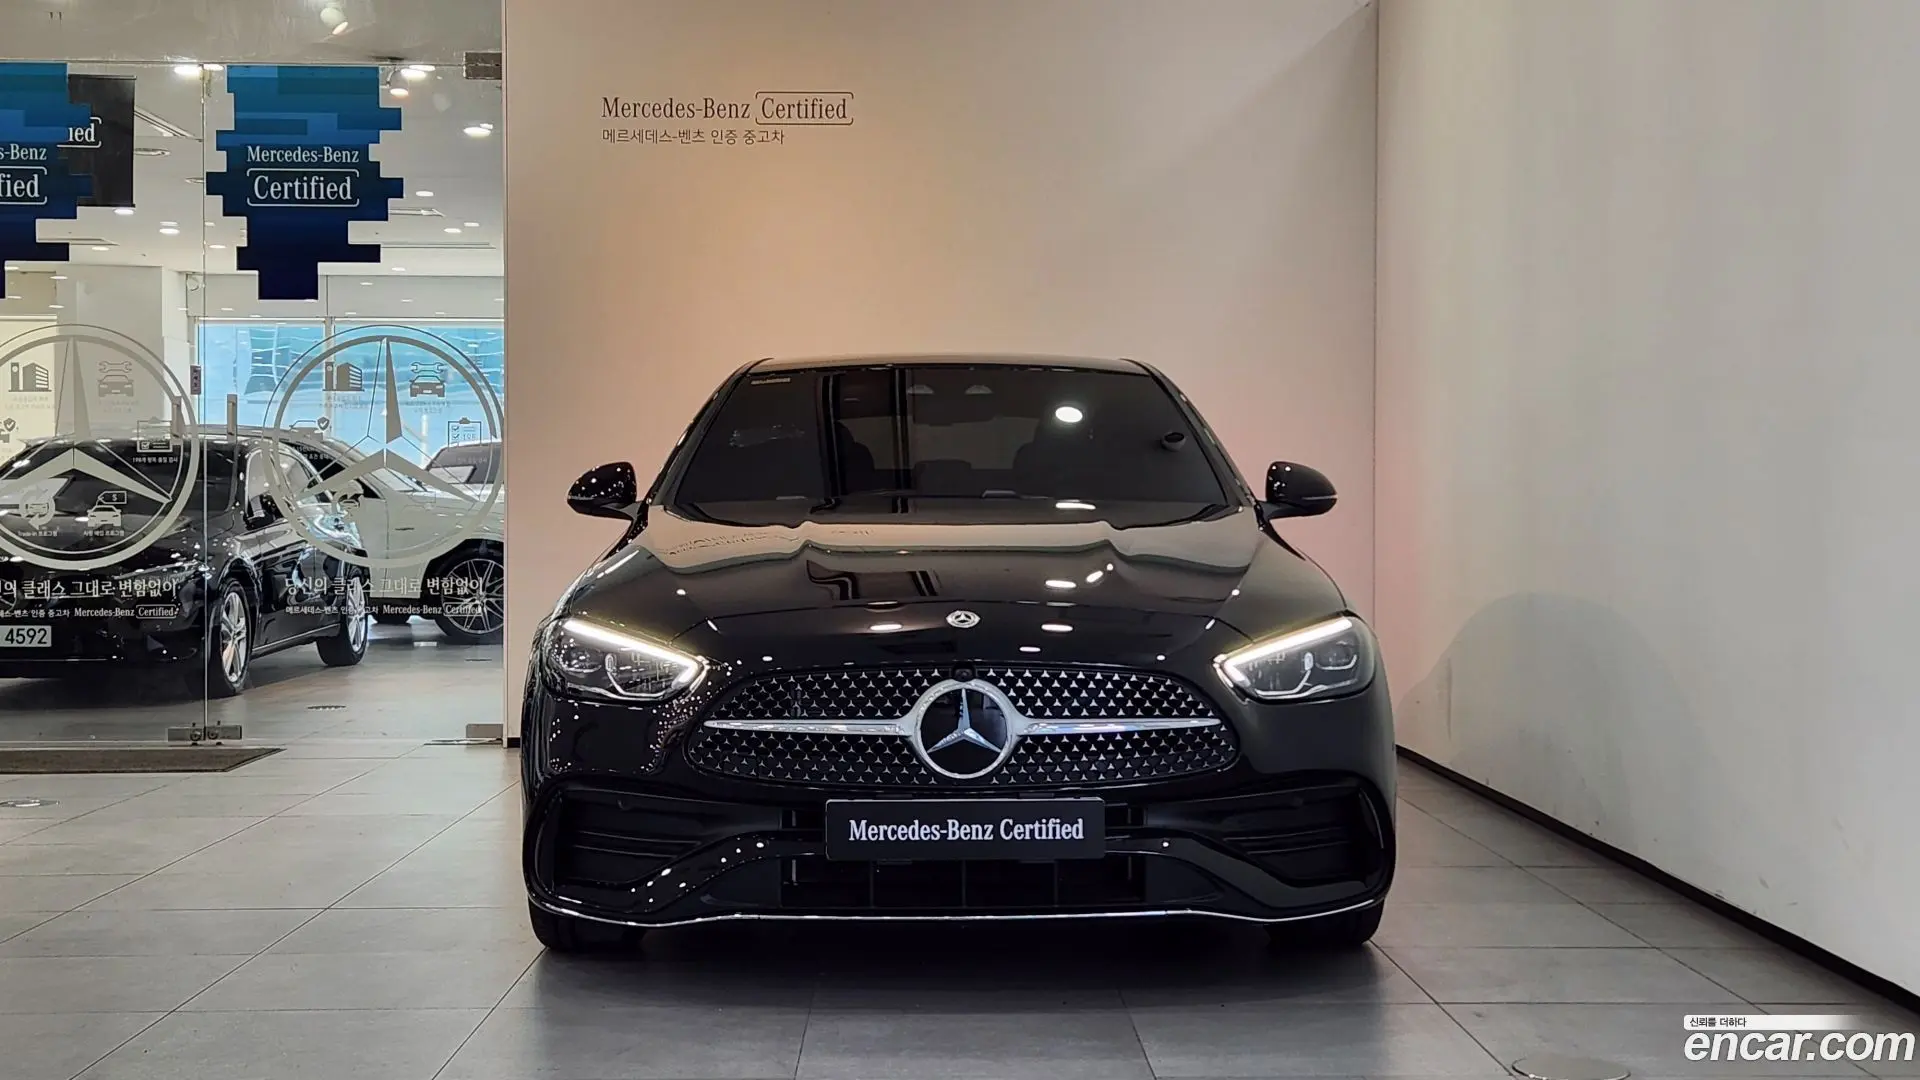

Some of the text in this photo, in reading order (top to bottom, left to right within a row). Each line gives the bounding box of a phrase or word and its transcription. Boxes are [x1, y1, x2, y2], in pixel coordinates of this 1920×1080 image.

[601, 97, 847, 120] Mercedes-Benz Certified
[602, 129, 785, 145] 메르세데스-벤츠 인증 중고차
[246, 145, 360, 163] Mercedes-Benz
[253, 175, 352, 201] Certified
[22, 579, 66, 600] 클래스
[70, 579, 115, 598] 그대로
[119, 579, 177, 598] 변함없이
[285, 577, 327, 596] 당신의
[379, 577, 422, 595] 그대로
[427, 577, 483, 596] 변함없이
[74, 607, 135, 617] Mercedes-Benz
[138, 606, 174, 616] Certified
[383, 604, 442, 614] Mercedes-Benz
[5, 628, 47, 645] 4592
[849, 818, 1085, 841] Mercedes-Benz Certified
